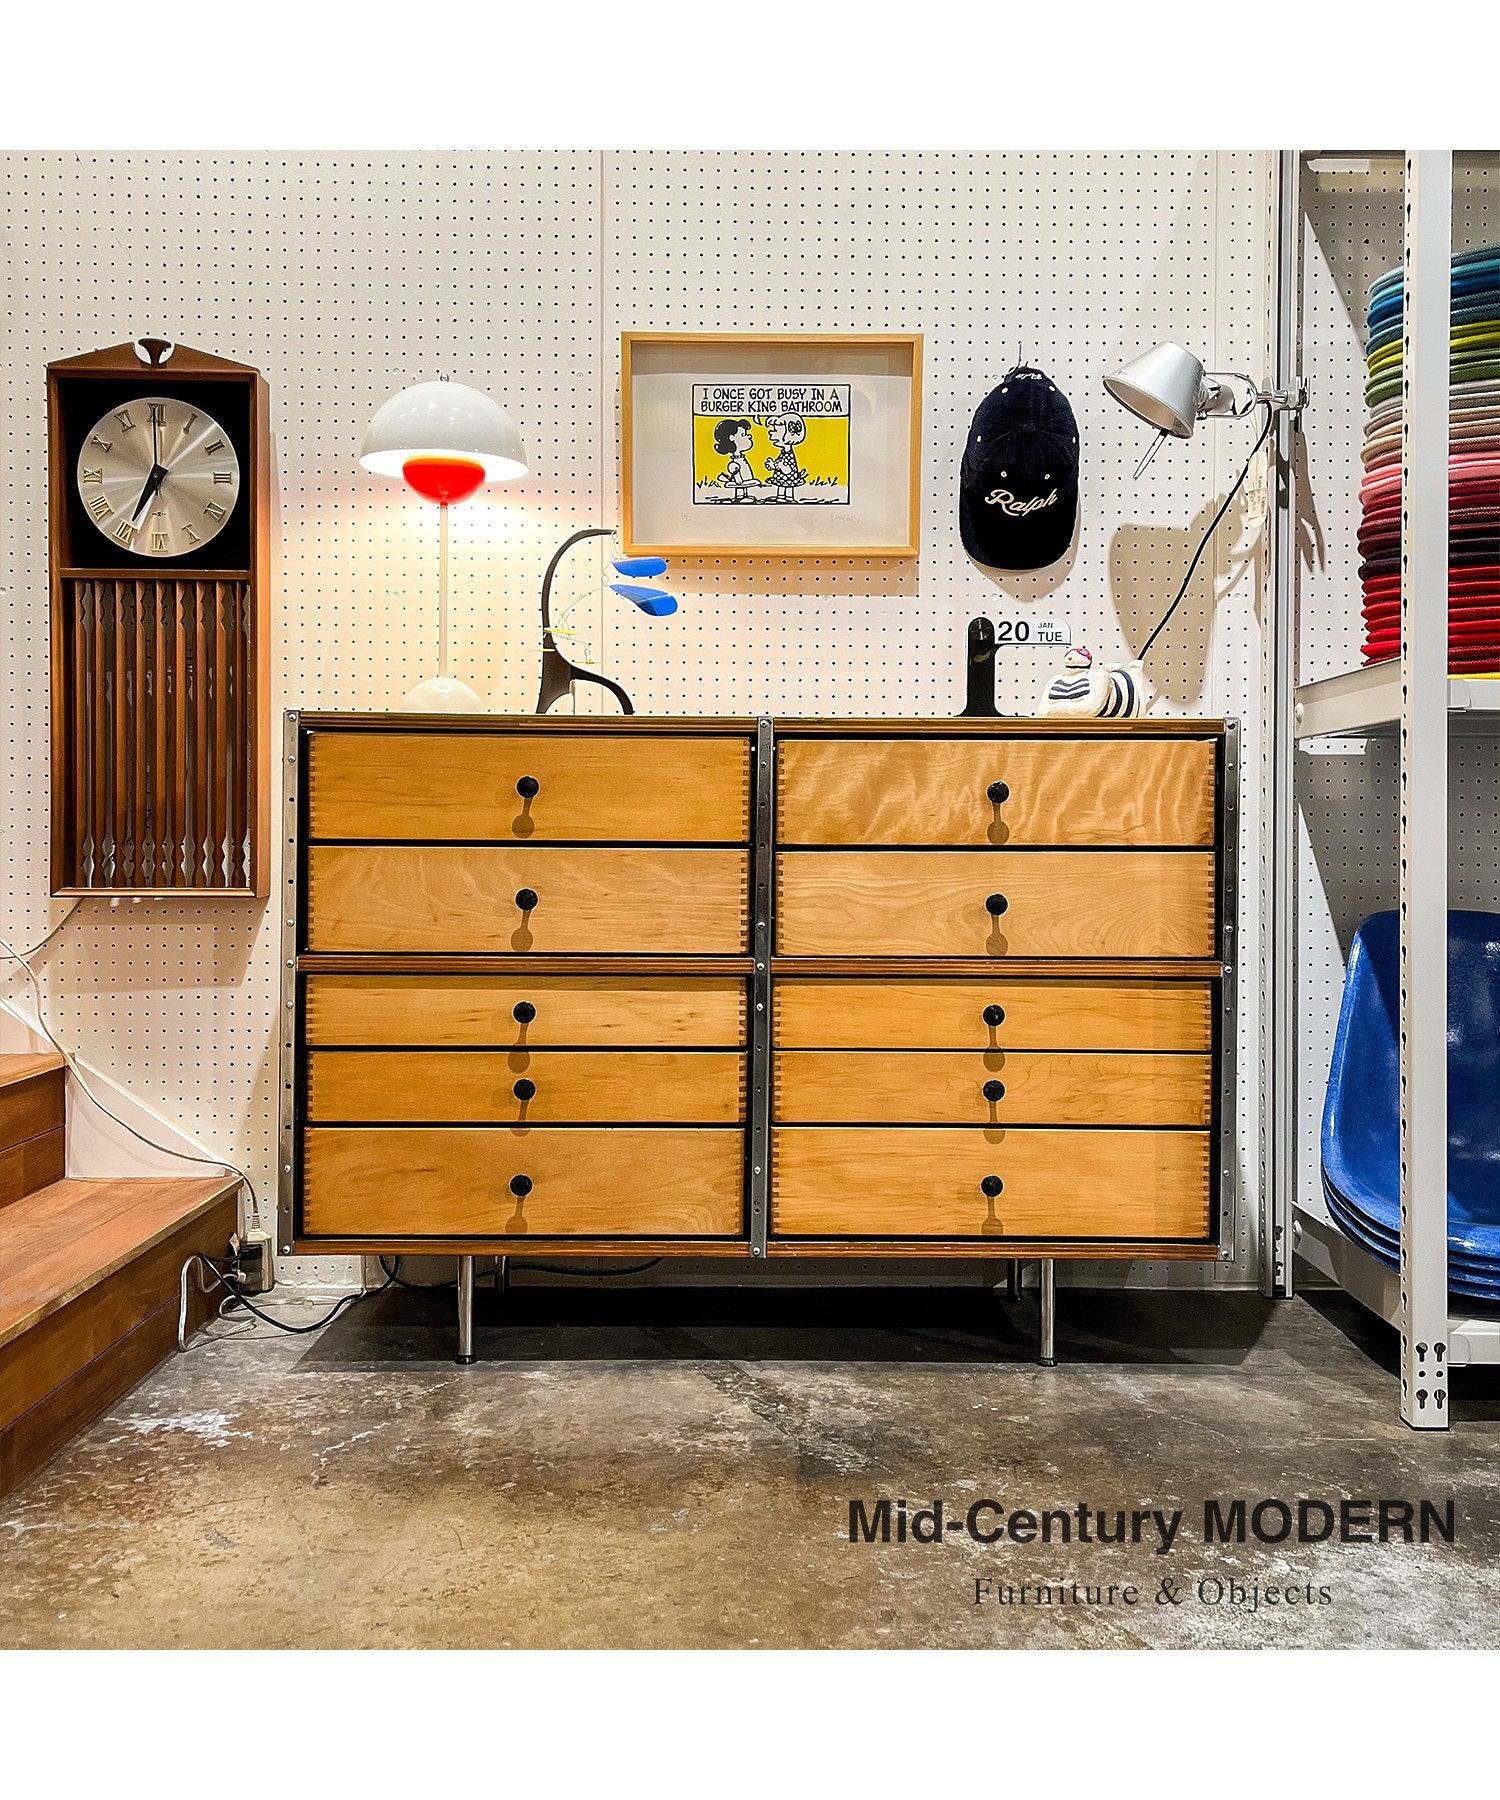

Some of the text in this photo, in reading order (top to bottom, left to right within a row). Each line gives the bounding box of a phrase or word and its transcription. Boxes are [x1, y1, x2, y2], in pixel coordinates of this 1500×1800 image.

[703, 388, 839, 400] I ONCE GOT BUSY IN A
[701, 401, 842, 413] BURGER KING BATHROOM
[114, 410, 136, 432] XI
[90, 434, 113, 453] X
[204, 439, 225, 455] II
[213, 471, 232, 485] III
[984, 488, 1058, 517] Ralph
[151, 532, 169, 553] VI
[998, 621, 1029, 641] 20
[1037, 631, 1063, 642] TUE
